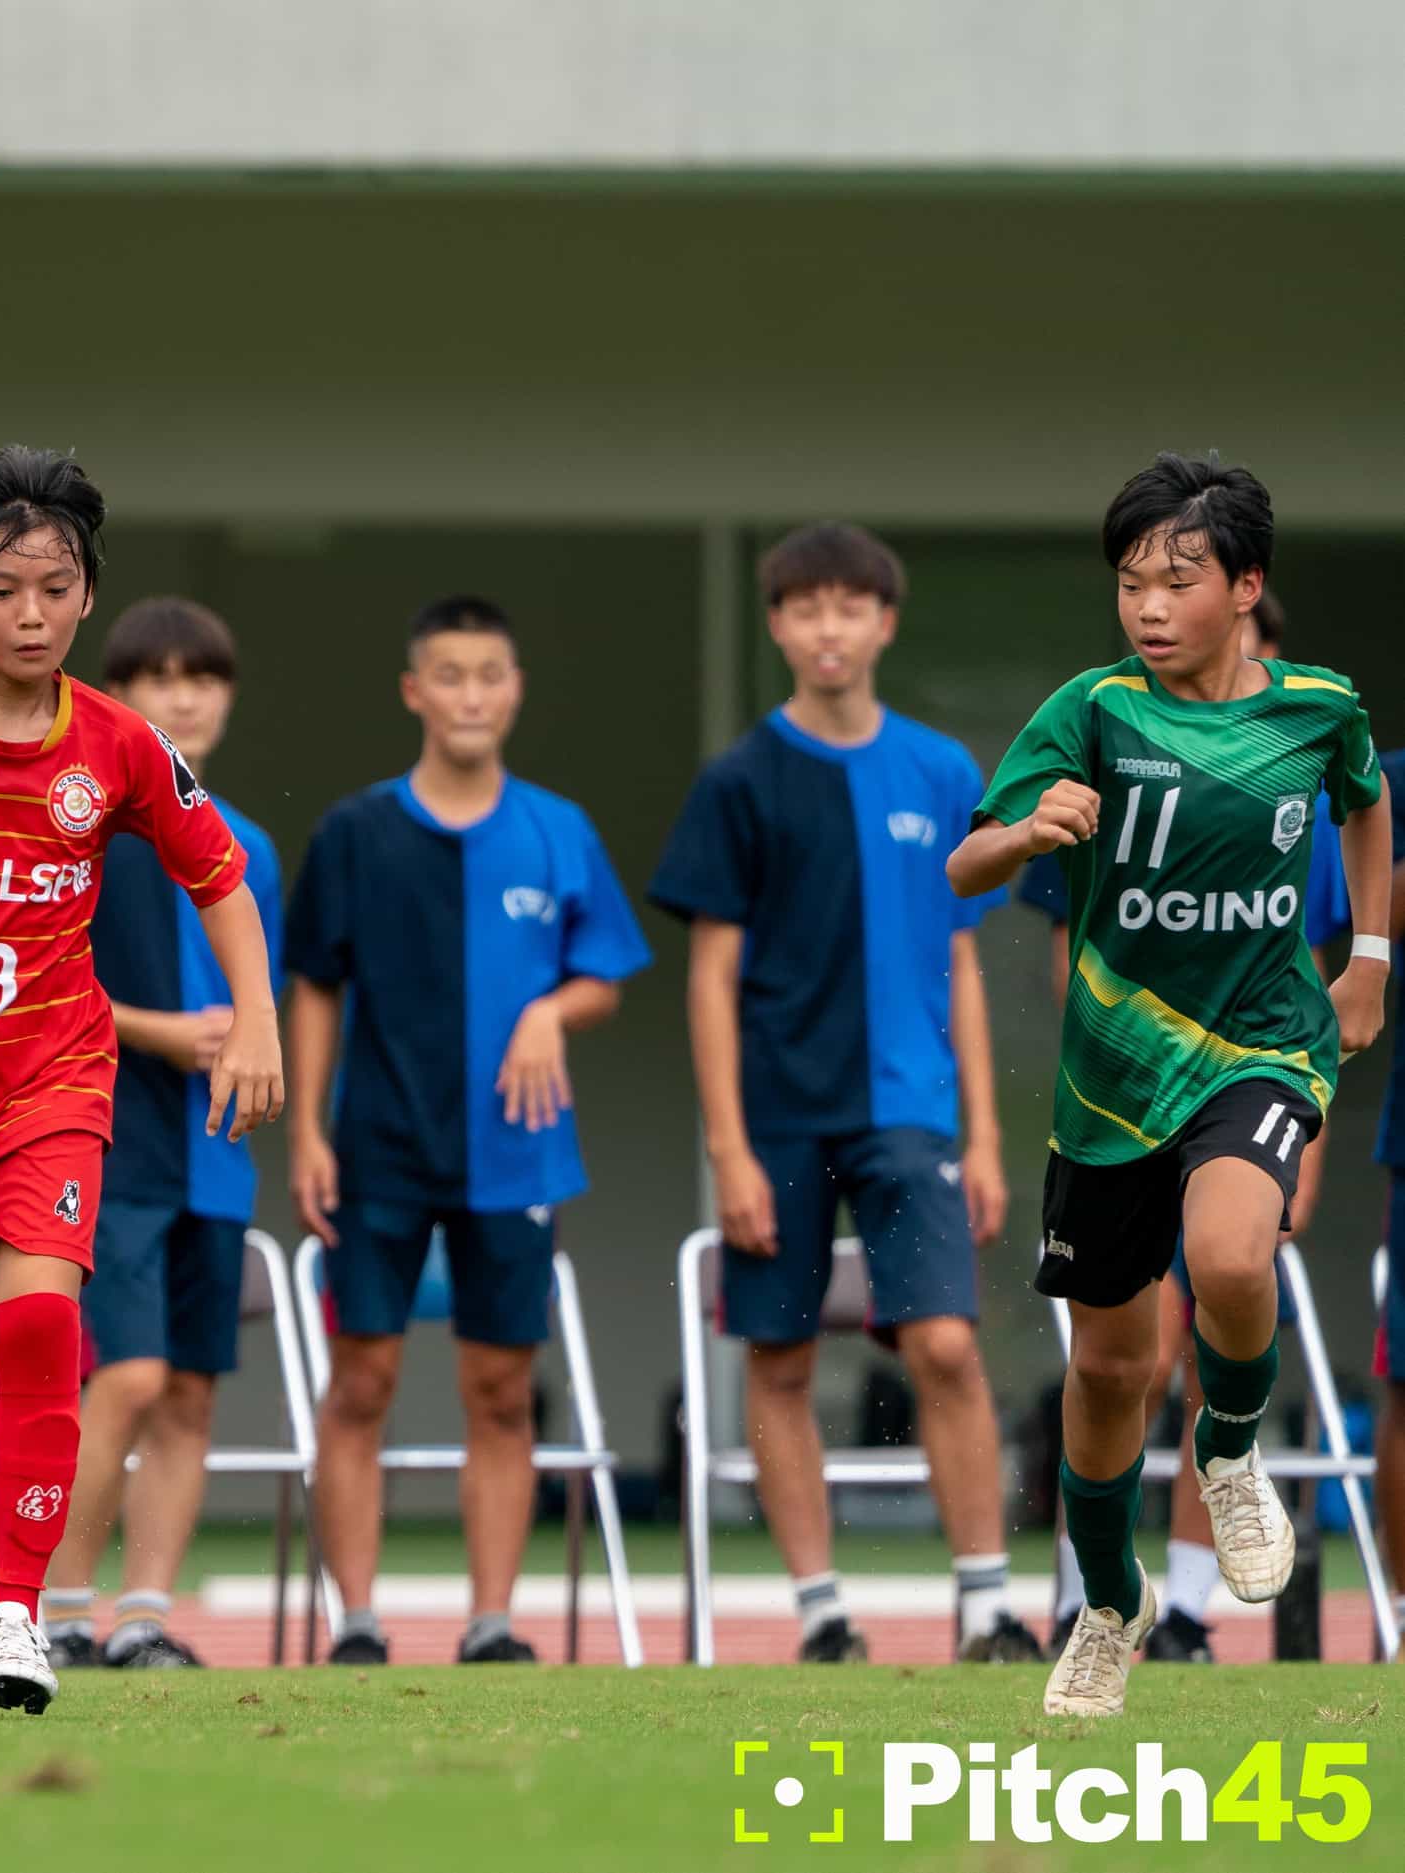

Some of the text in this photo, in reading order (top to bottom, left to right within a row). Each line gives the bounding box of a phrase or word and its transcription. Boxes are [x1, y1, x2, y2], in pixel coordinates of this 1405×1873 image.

[1115, 784, 1182, 869] 11
[1118, 884, 1298, 932] OGINO
[1251, 1102, 1300, 1163] 11
